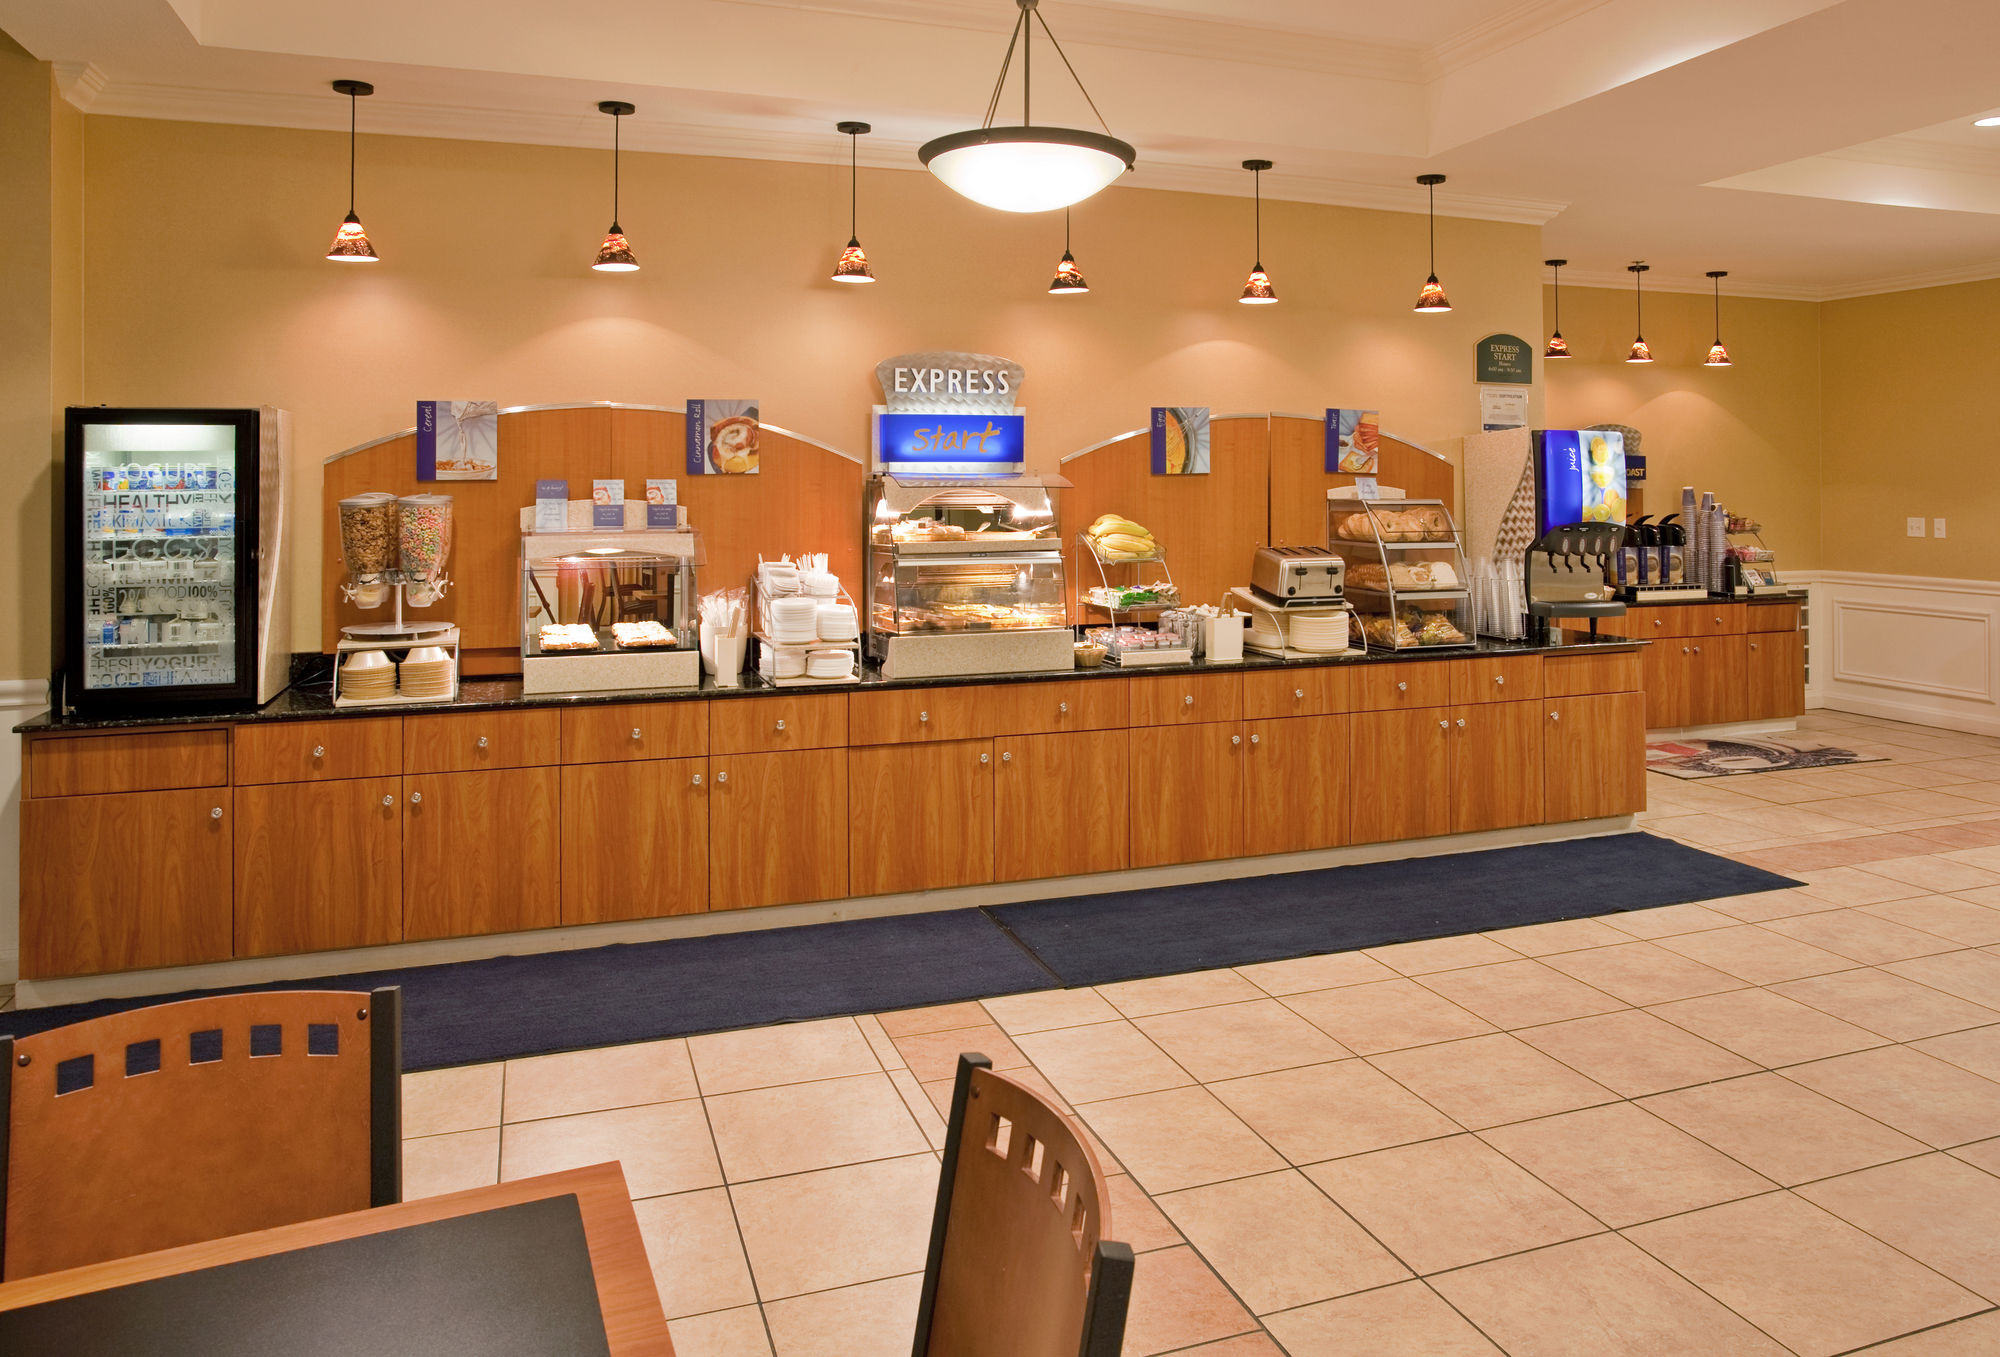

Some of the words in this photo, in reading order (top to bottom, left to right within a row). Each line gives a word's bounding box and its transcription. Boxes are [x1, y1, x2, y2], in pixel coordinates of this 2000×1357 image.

[1490, 345, 1520, 353] EXPRESS
[1493, 353, 1517, 361] START
[894, 367, 1010, 395] EXPRESS
[421, 404, 432, 433] Cereal
[690, 403, 701, 418] Roll
[693, 420, 702, 464] Cinnamon
[1563, 447, 1580, 472] juice
[111, 462, 210, 482] YOGURT
[112, 536, 210, 562] EGGS
[188, 584, 218, 598] 100%
